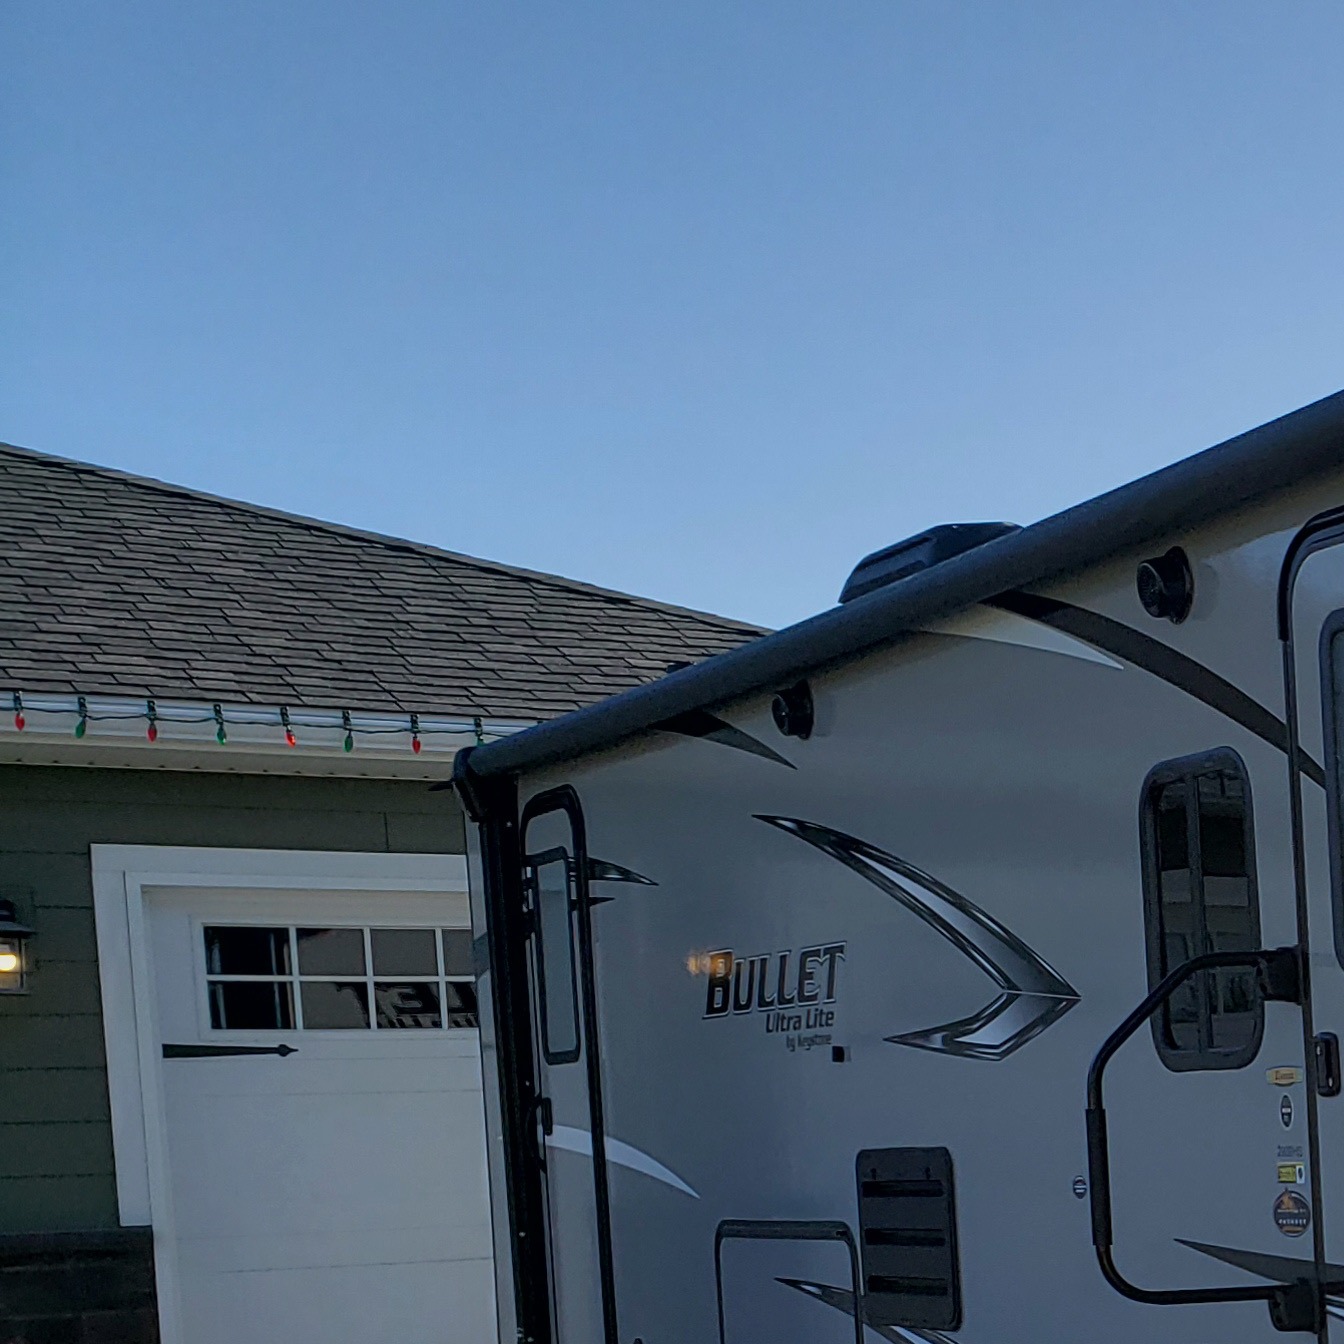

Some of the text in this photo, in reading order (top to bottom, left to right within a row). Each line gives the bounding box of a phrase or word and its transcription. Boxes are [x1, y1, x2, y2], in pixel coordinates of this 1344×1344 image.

[702, 940, 847, 1020] BULLET
[766, 1009, 834, 1034] Ultra Lite
